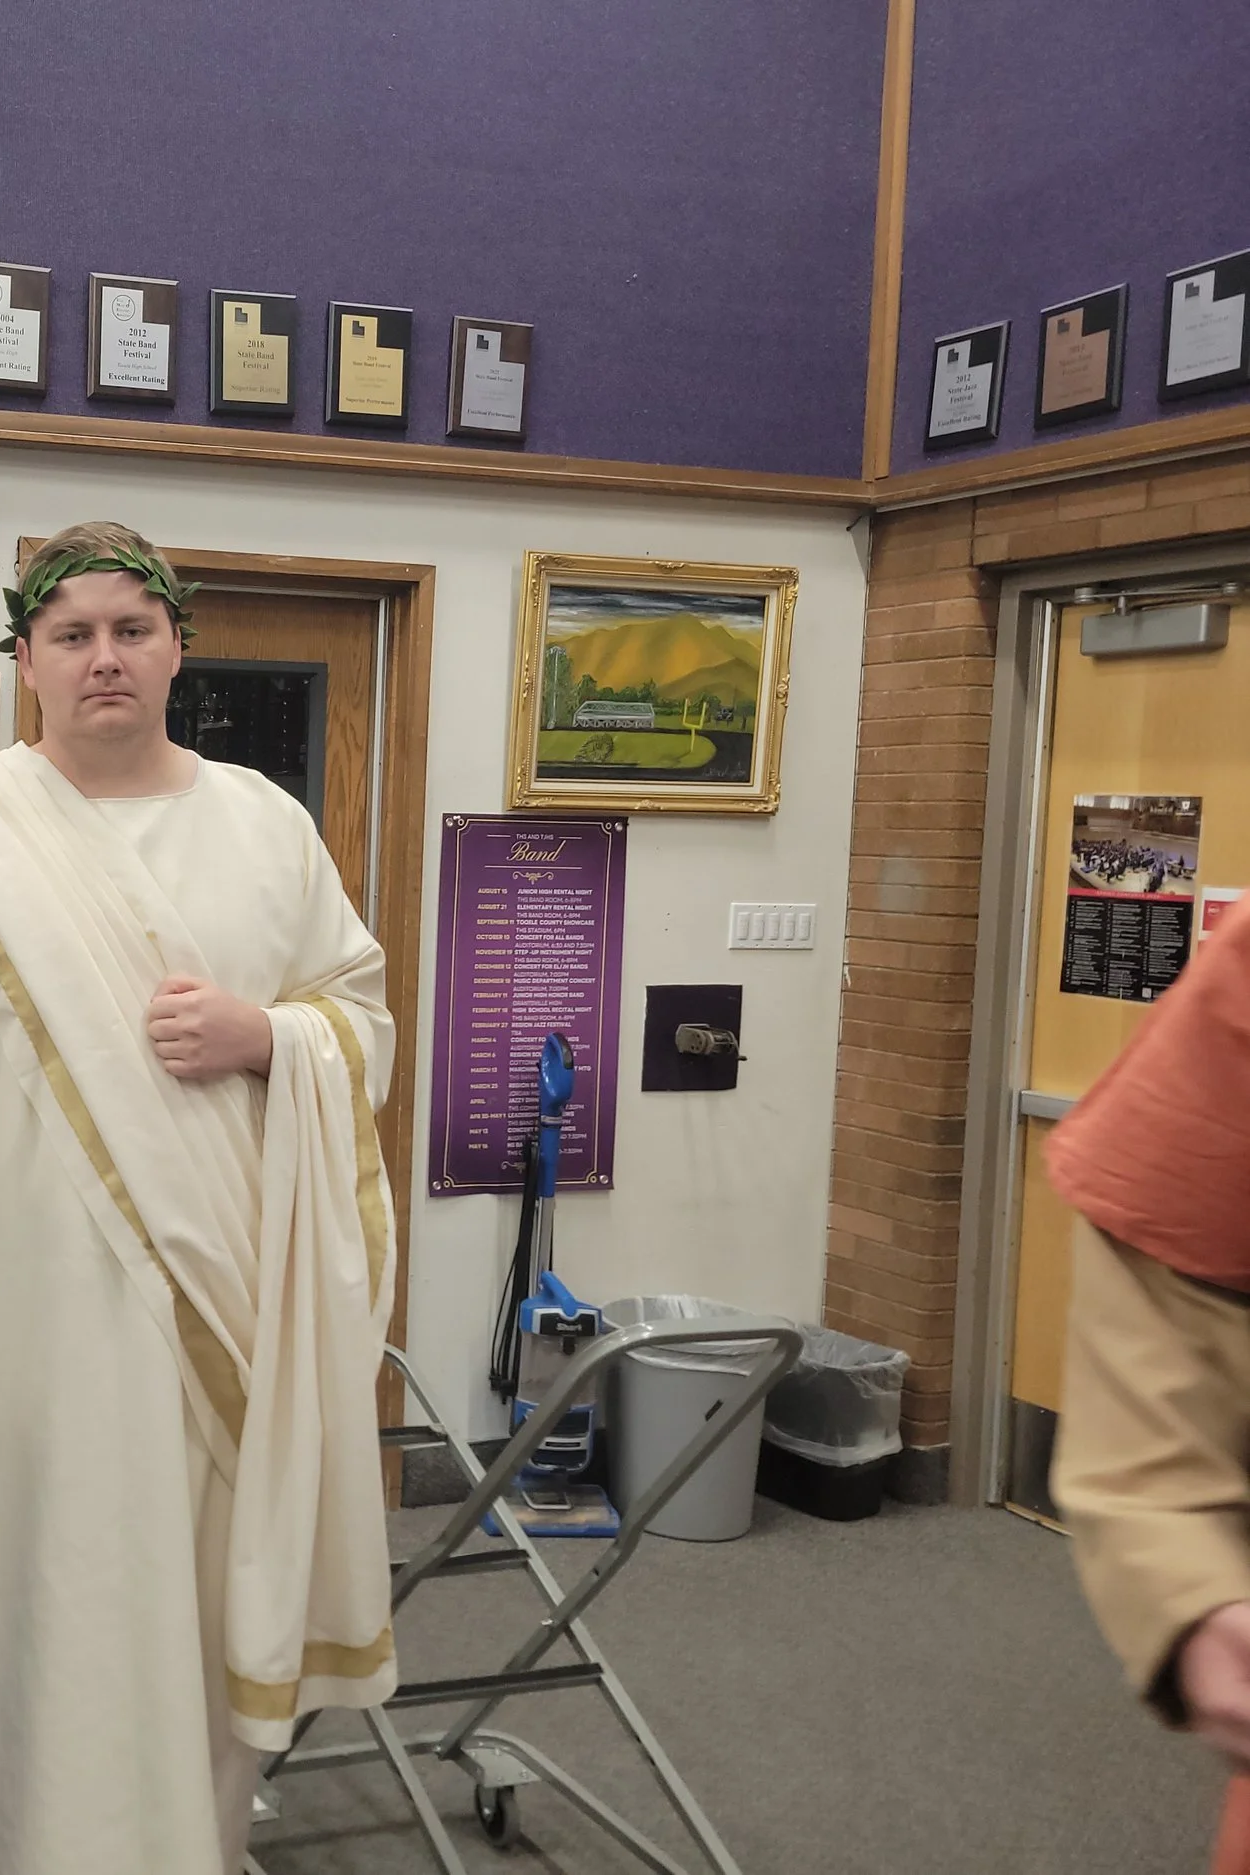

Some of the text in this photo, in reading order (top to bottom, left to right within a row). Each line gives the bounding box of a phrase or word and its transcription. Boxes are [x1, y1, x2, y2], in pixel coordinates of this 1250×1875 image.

[5, 326, 25, 335] Band
[129, 328, 147, 337] 2012
[118, 339, 157, 349] State Band
[247, 340, 265, 348] 2018
[124, 350, 151, 359] Festival
[238, 351, 274, 360] State Band
[8, 362, 31, 372] Rating
[243, 361, 269, 369] Festival
[108, 372, 165, 385] Excellent Rating
[506, 840, 566, 861] Band
